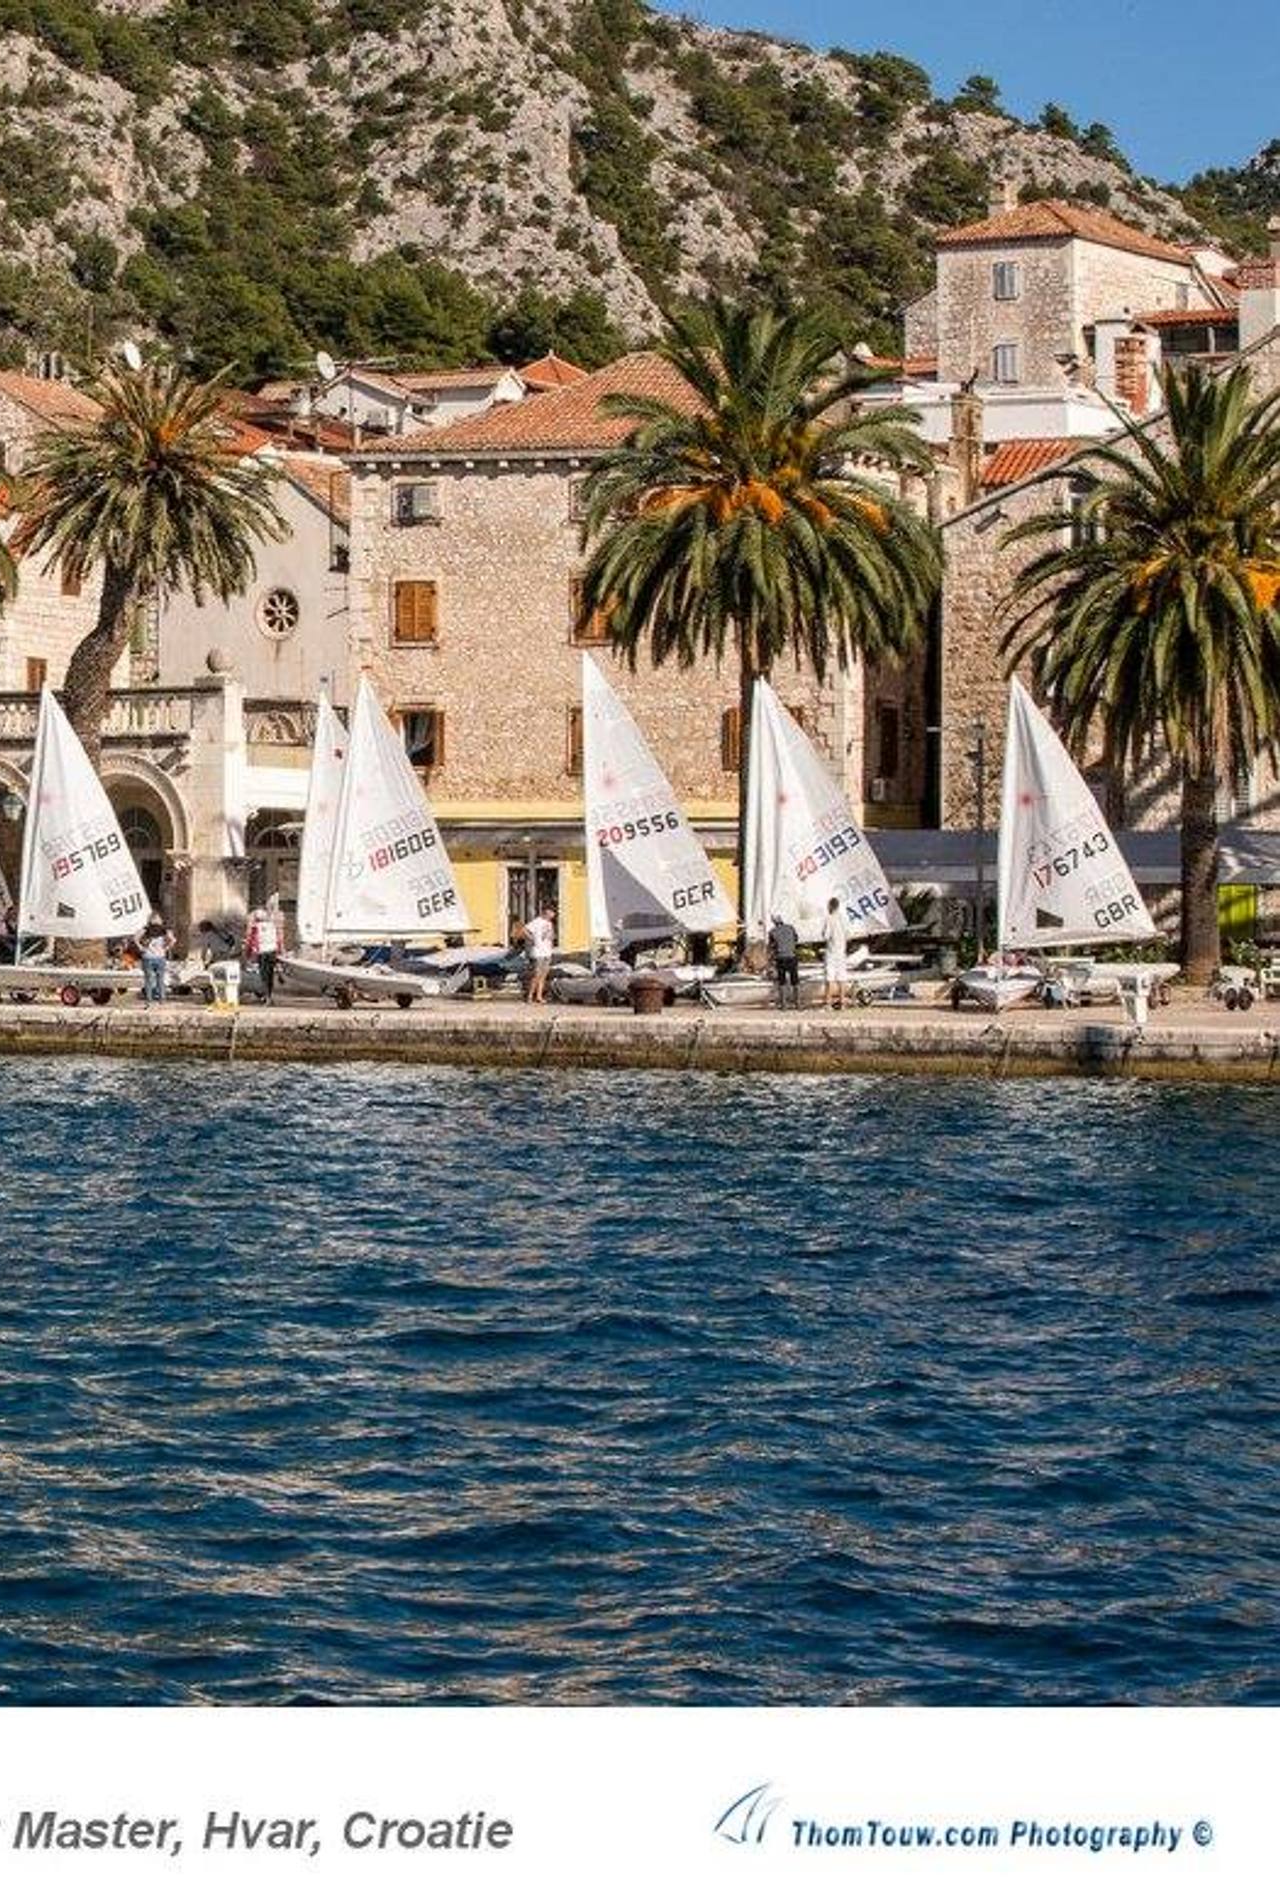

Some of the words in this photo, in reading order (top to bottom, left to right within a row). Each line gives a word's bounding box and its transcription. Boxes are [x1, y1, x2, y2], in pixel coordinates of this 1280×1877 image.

[595, 811, 679, 848] 209556
[51, 832, 121, 880] 195769
[368, 828, 436, 872] 181606
[795, 826, 861, 882] 203193
[1033, 832, 1110, 889] 176743
[109, 892, 143, 920] SUI
[416, 889, 458, 918] GER
[673, 881, 716, 910] GER
[845, 887, 889, 922] ARG
[1094, 894, 1140, 928] GBR
